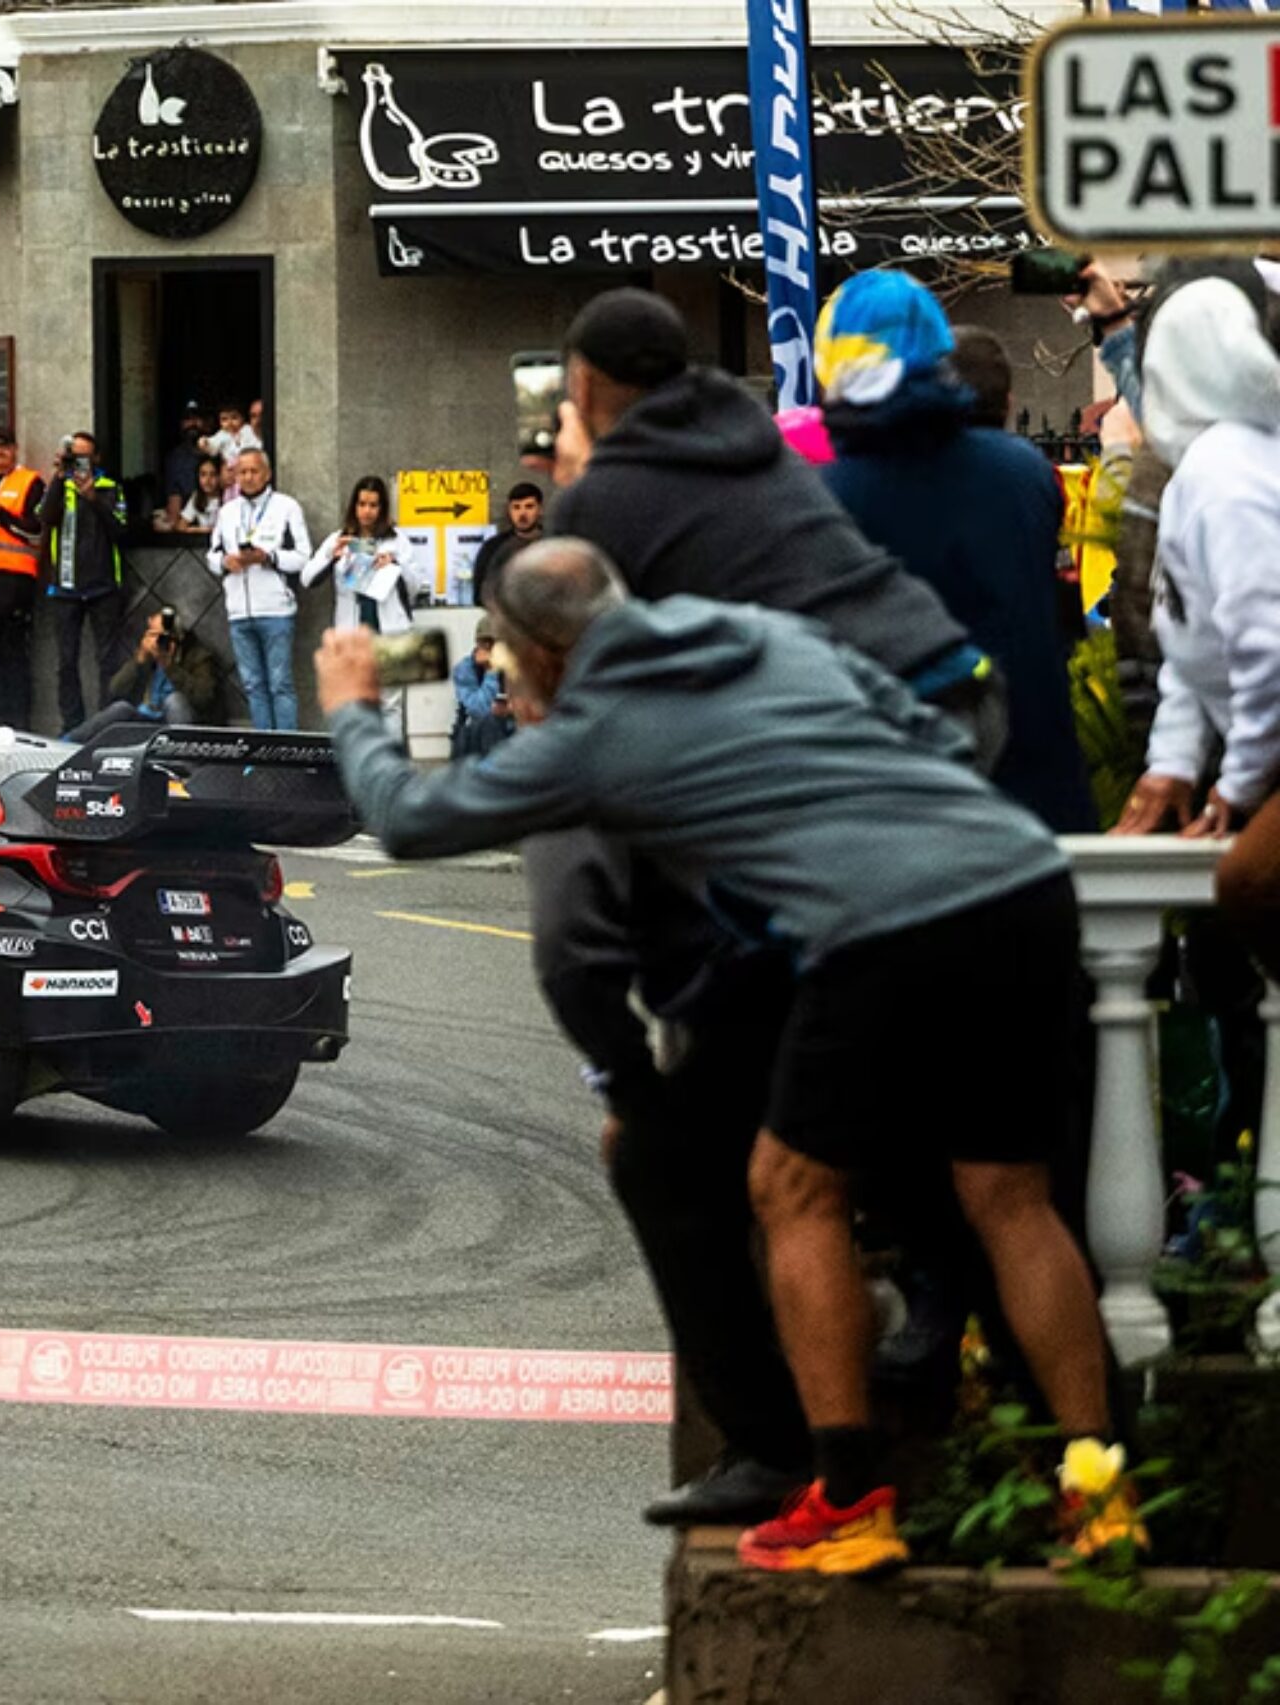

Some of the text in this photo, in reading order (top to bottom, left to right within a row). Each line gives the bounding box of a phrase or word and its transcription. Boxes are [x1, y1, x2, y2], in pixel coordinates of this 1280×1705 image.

[532, 81, 625, 136] La
[1066, 55, 1238, 120] LAS
[94, 135, 119, 160] La
[539, 150, 673, 171] quesos
[684, 150, 703, 175] y
[1066, 136, 1280, 209] PAL
[520, 226, 575, 264] La
